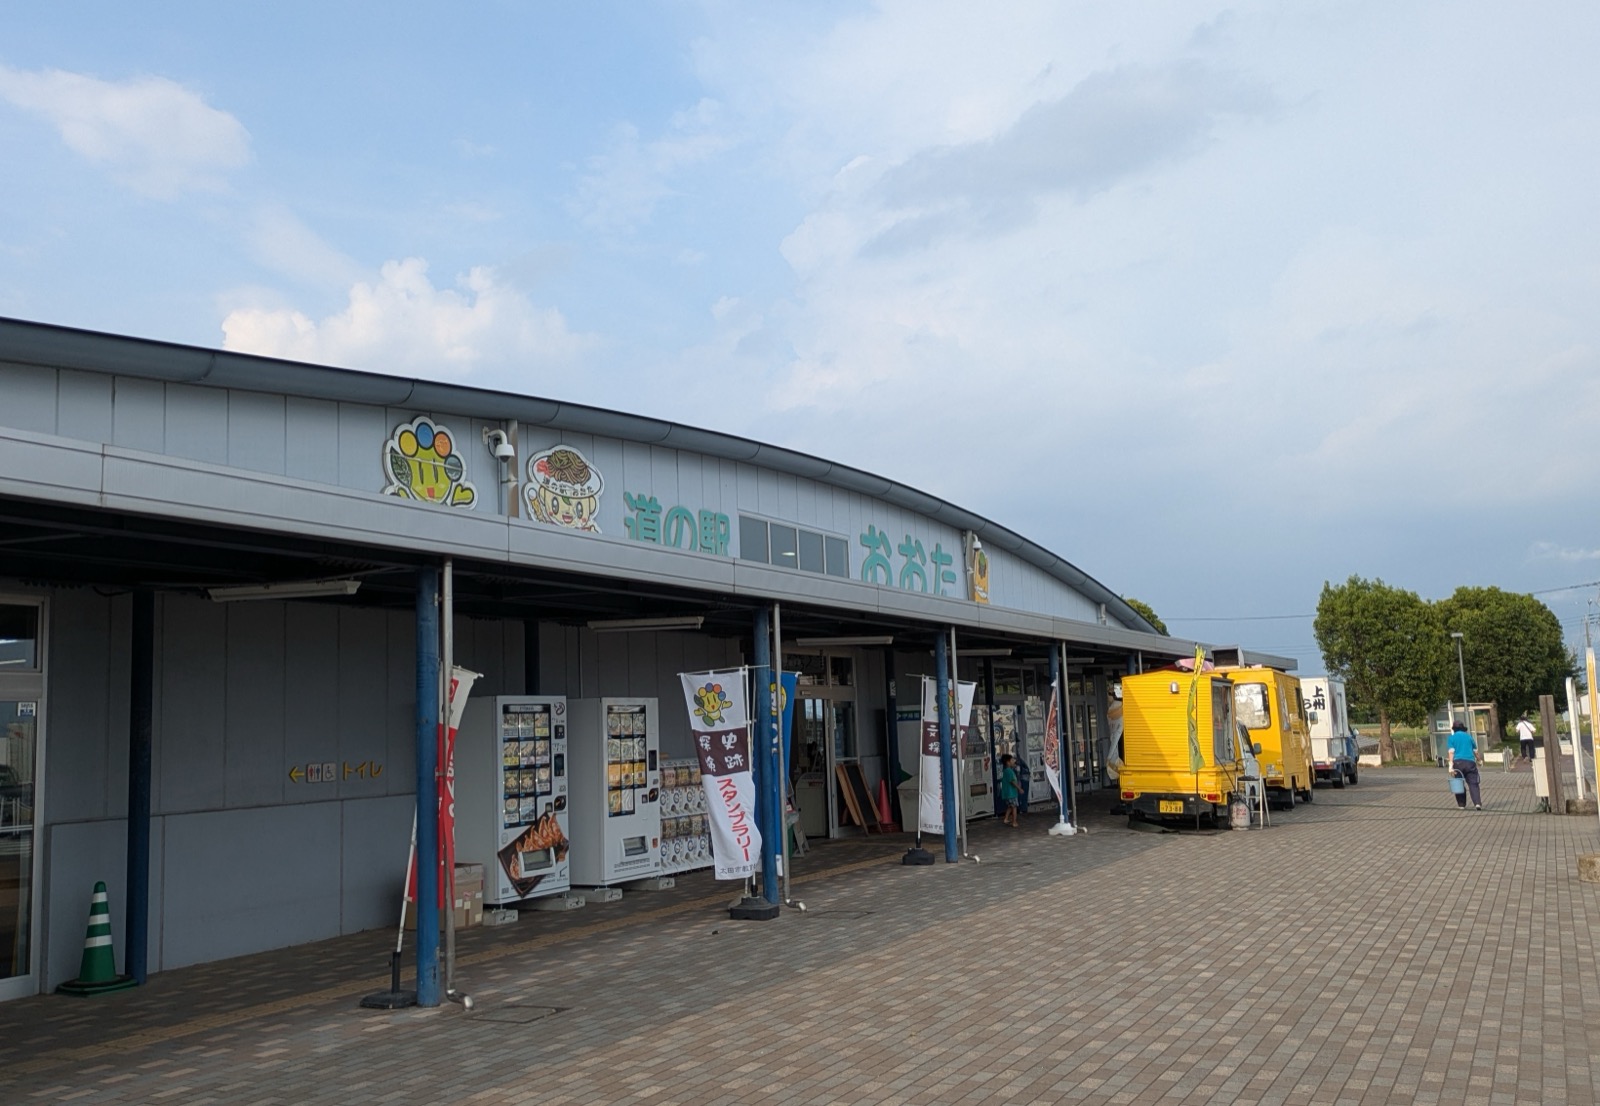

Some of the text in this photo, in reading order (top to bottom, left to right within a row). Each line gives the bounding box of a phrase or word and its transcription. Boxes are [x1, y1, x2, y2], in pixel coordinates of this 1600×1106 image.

[623, 491, 956, 596] 道の駅 おおた
[1312, 685, 1326, 711] 上州
[343, 761, 384, 781] トイレ
[717, 778, 750, 862] スタンプラリー
